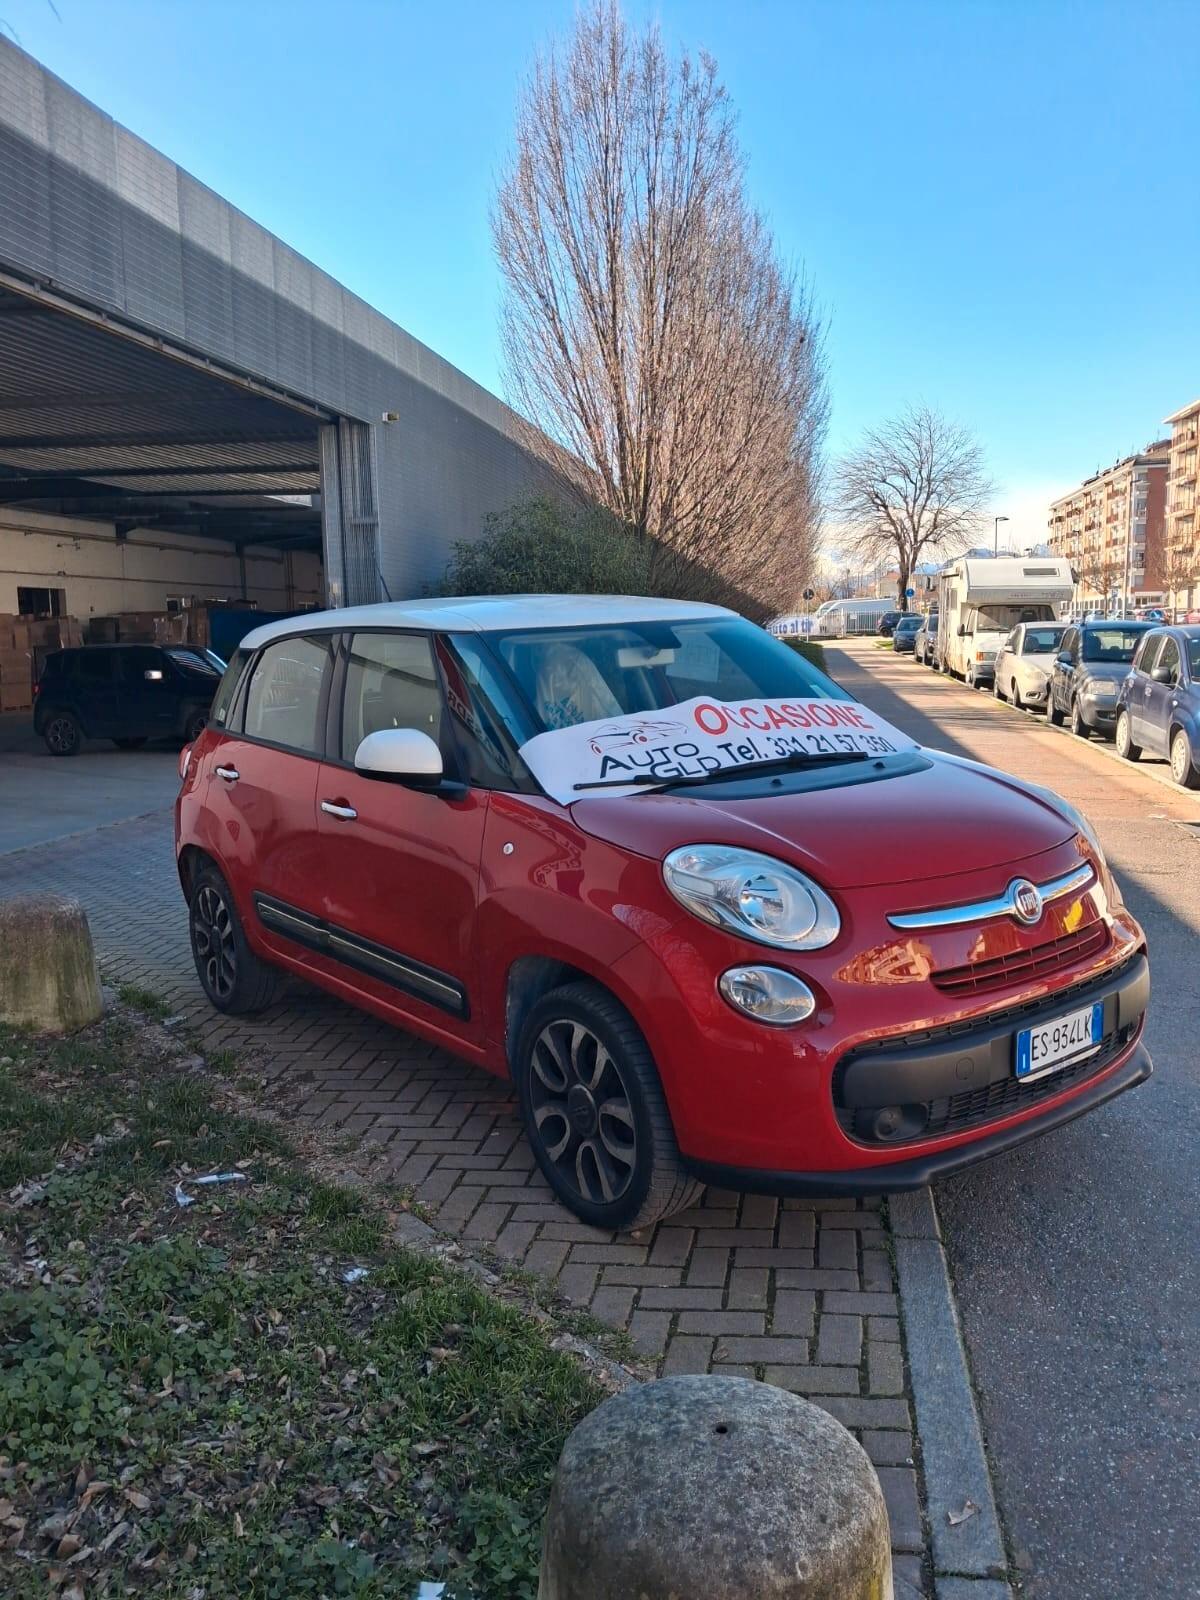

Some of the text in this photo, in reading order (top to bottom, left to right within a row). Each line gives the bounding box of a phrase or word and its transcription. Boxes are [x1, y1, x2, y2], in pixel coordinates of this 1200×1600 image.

[693, 703, 874, 736] OCCASIONE
[600, 742, 700, 779] AUTO
[717, 737, 769, 764] Tel.
[806, 734, 838, 753] 21
[833, 734, 862, 752] 57
[858, 734, 898, 753] 350
[1031, 1013, 1092, 1062] ES 934LK
